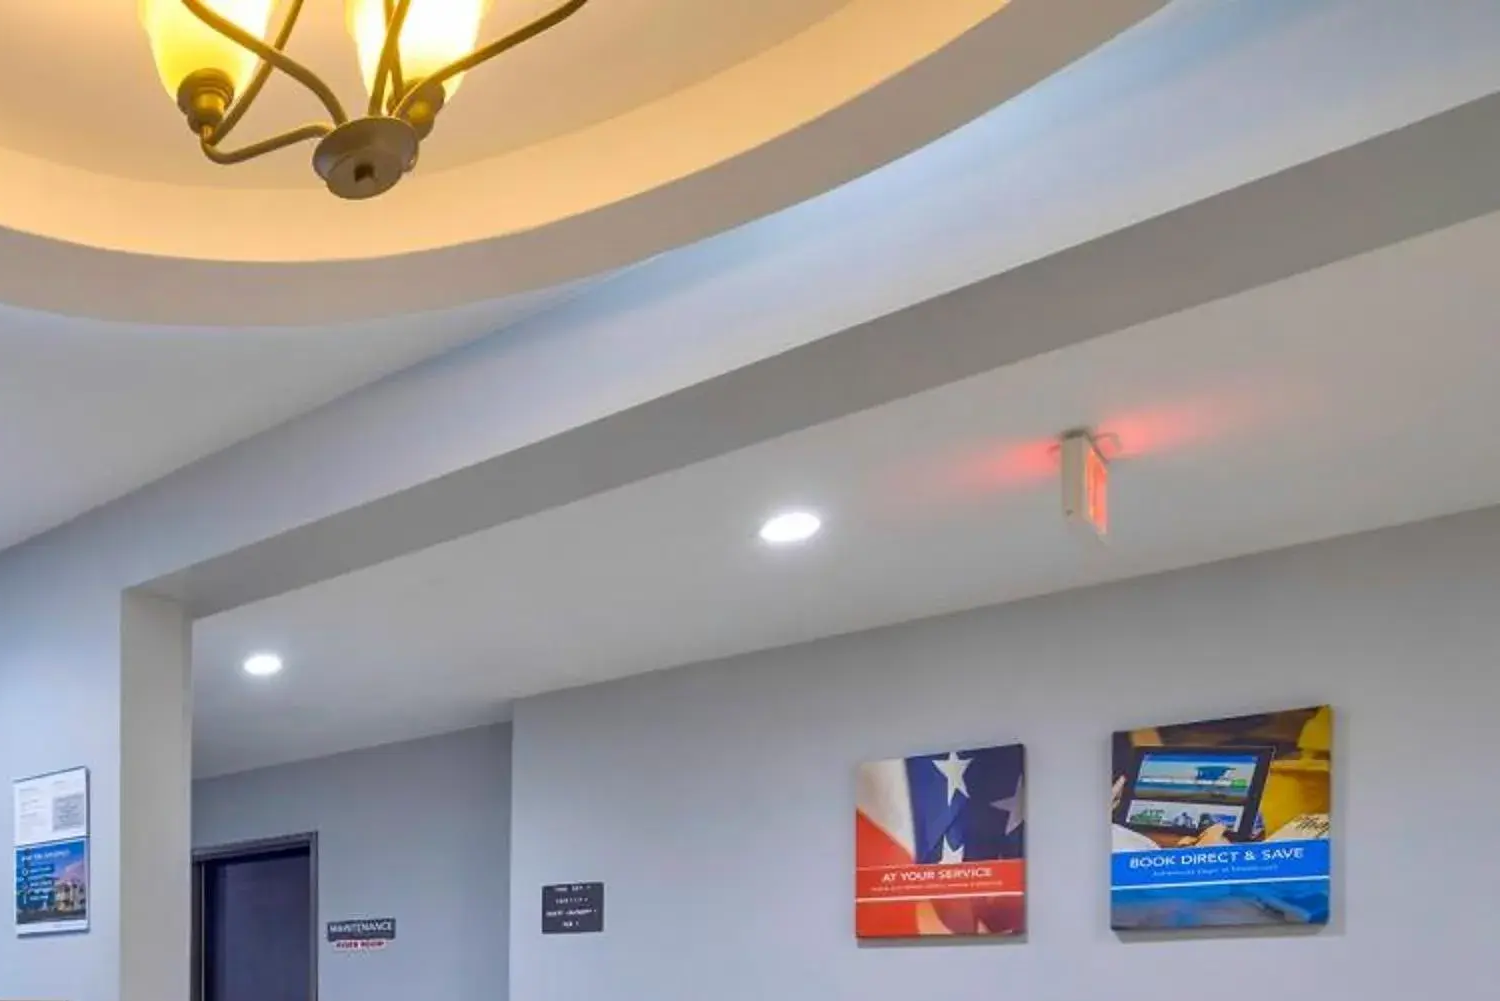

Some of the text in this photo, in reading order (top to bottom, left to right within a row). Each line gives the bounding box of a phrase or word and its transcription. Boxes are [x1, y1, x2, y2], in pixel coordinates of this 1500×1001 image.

[1129, 847, 1305, 869] BOOK DIRECT & SAVE
[882, 867, 993, 882] AT YOUR SERVICE
